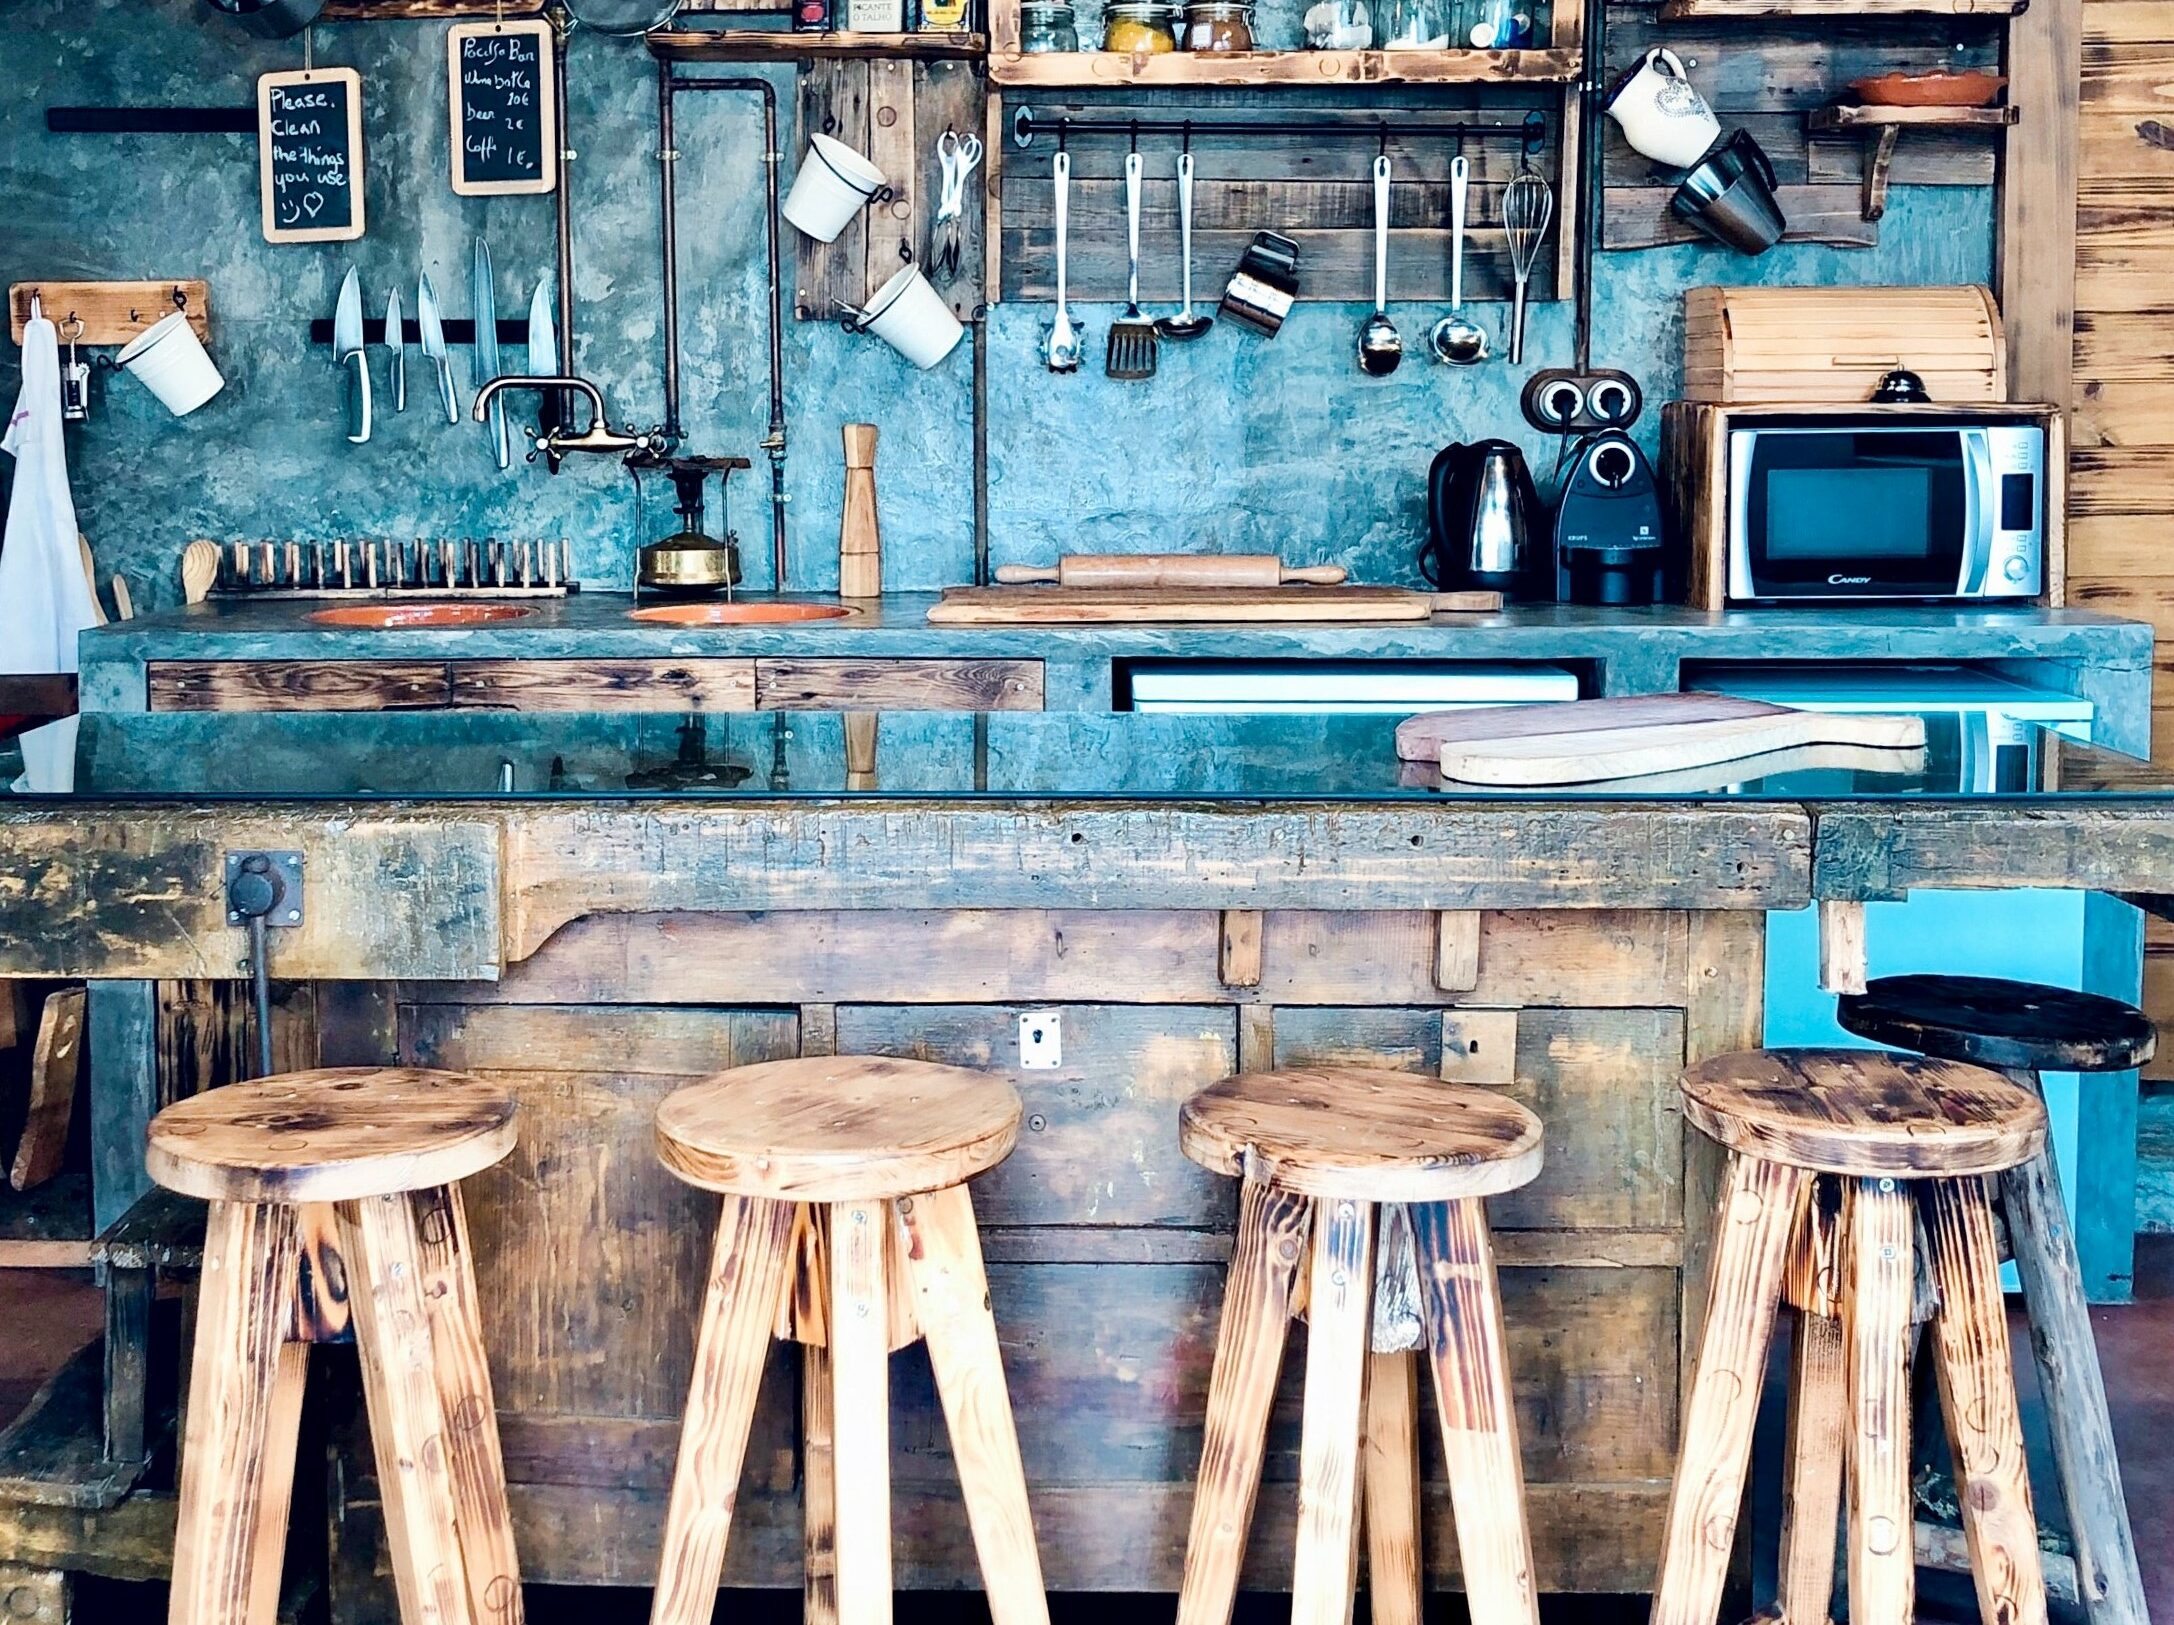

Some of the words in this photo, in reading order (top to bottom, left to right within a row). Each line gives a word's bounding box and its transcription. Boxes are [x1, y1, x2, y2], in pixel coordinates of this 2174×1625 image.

[507, 92, 529, 106] 10€
[271, 119, 321, 136] Clean
[273, 145, 297, 162] the
[300, 145, 345, 174] things
[275, 172, 310, 193] you
[317, 171, 347, 186] use
